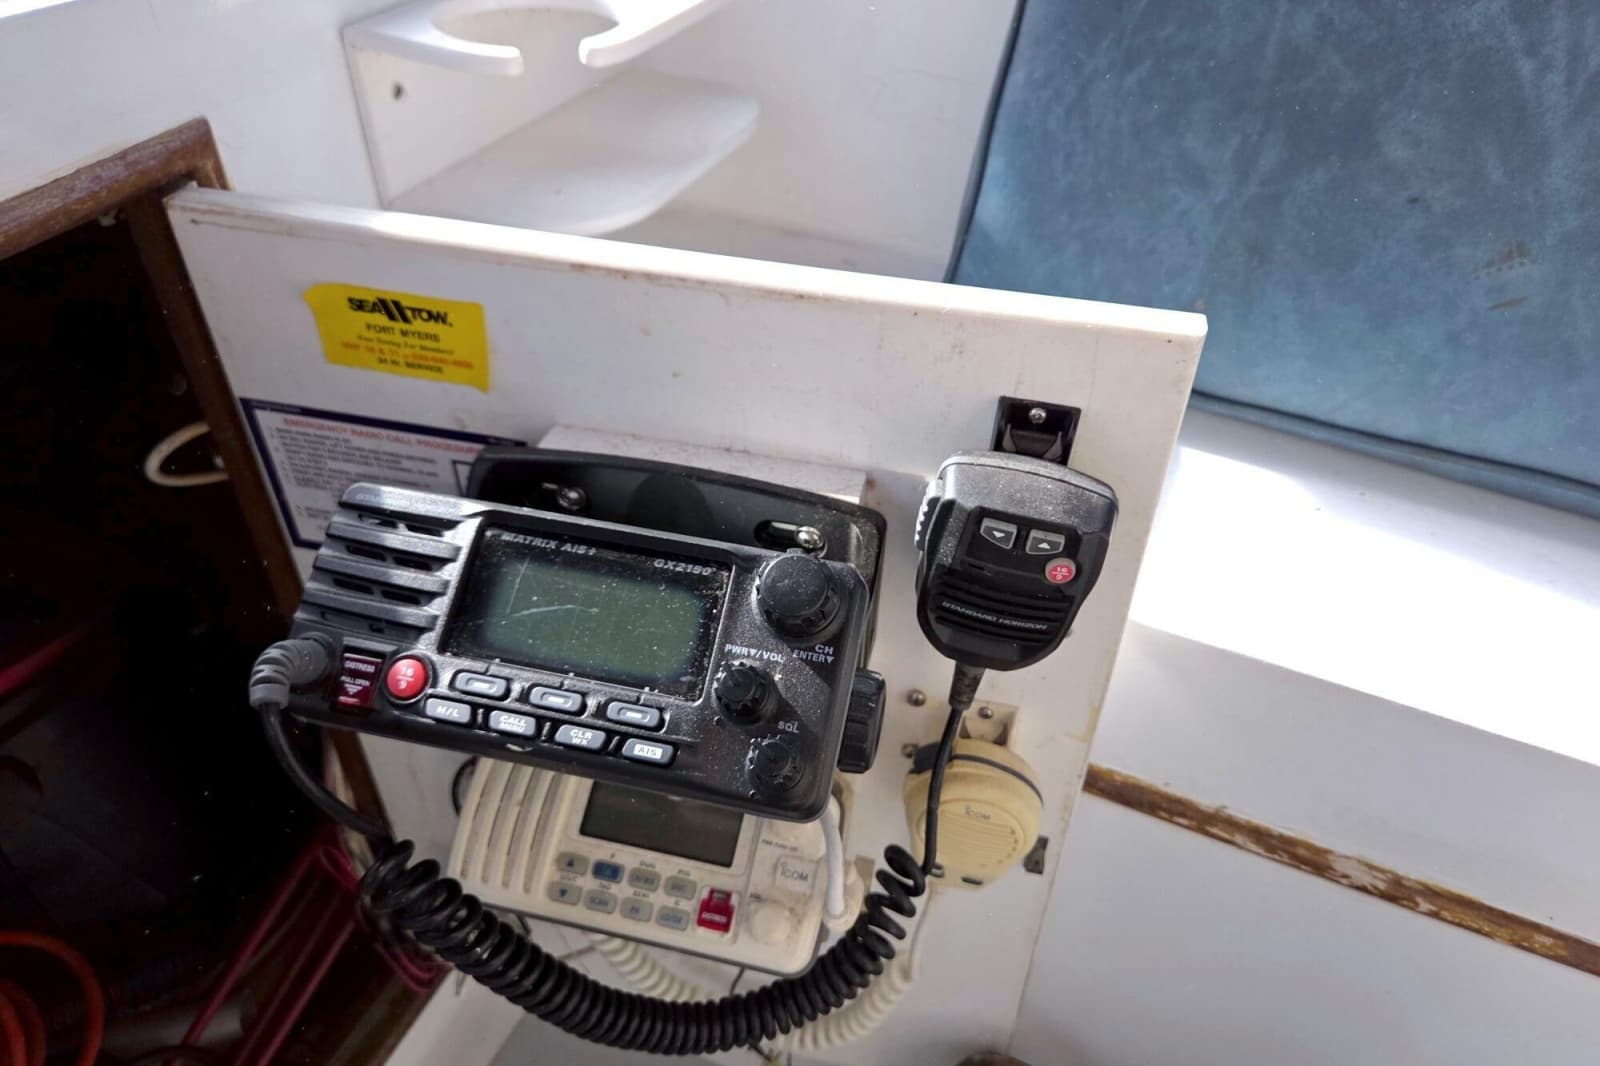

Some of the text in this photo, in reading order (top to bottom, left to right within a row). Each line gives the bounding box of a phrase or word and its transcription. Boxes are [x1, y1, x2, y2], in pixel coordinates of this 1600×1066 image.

[348, 296, 385, 315] SEA
[366, 323, 441, 343] FORT MYERS
[351, 425, 385, 441] RADIO
[386, 432, 412, 446] CALL
[501, 532, 559, 550] MATRIX
[653, 558, 714, 576] GX2150
[942, 601, 1048, 630] STANDARD HORIZON
[815, 644, 834, 655] CH
[344, 660, 376, 673] DISTRESS
[400, 666, 415, 677] 16
[399, 680, 407, 689] 9
[436, 705, 460, 717] H/L
[500, 715, 527, 727] CALL
[777, 720, 800, 734] SQL
[570, 729, 592, 740] CLR
